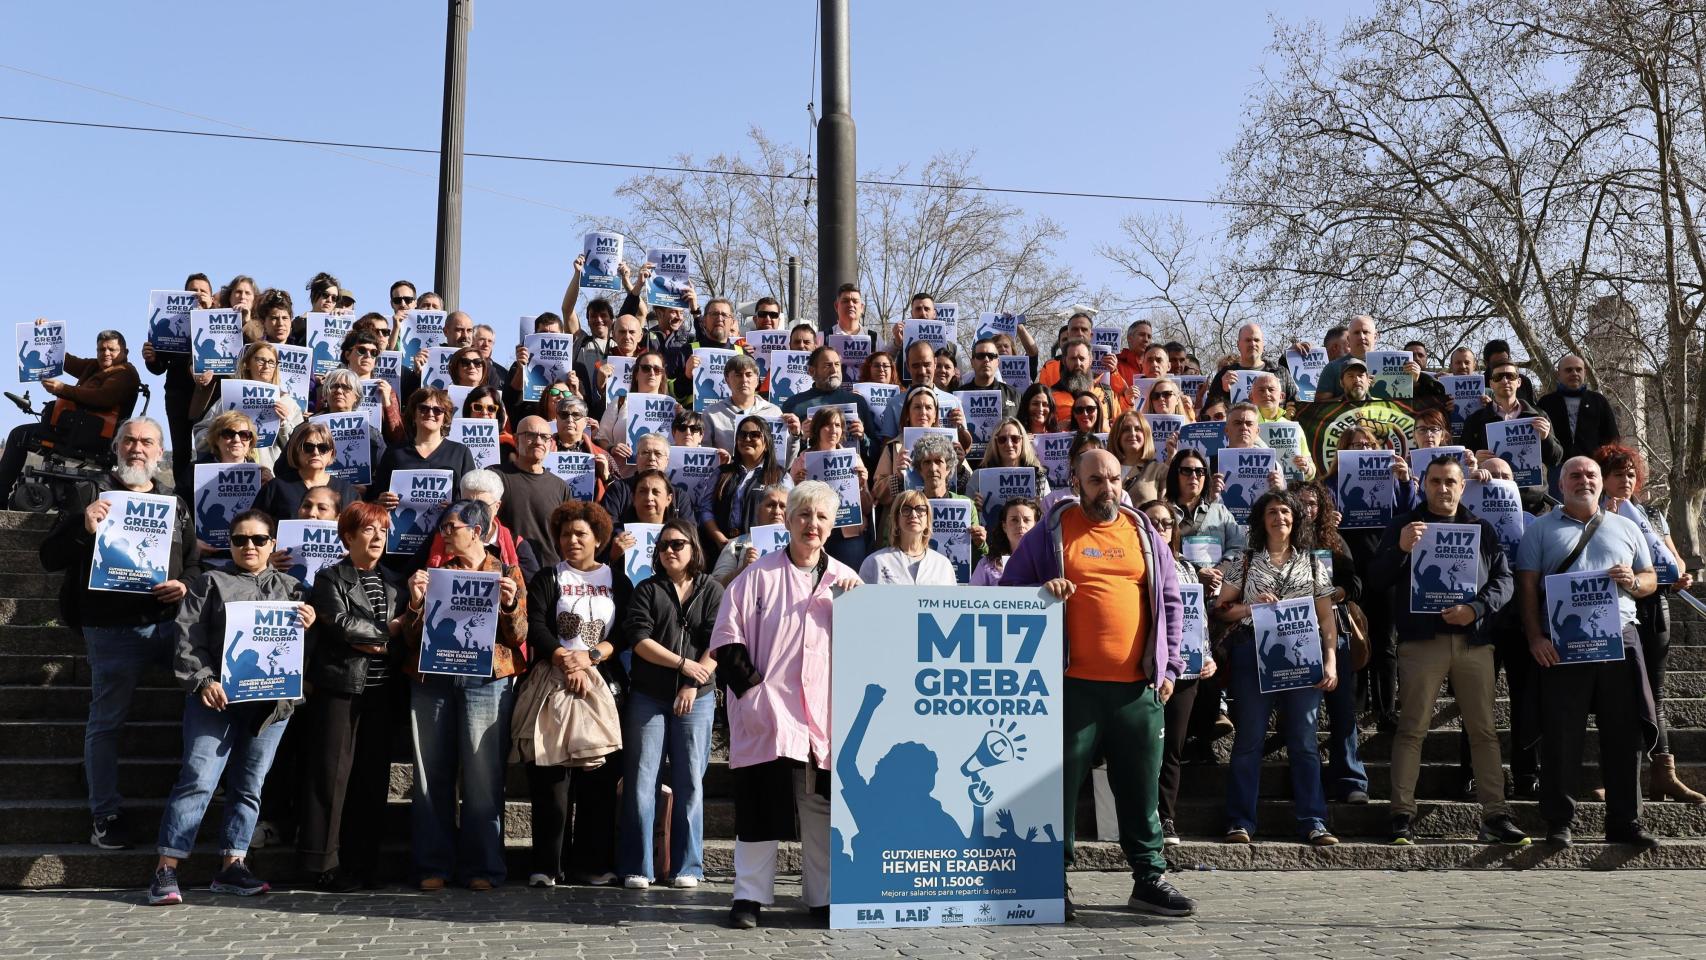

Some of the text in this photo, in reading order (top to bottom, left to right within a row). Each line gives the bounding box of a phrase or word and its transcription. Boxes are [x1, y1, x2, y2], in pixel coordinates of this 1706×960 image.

[596, 238, 618, 247] M17
[661, 254, 686, 263] M17
[167, 296, 194, 305] M17
[209, 314, 238, 324] M17
[324, 318, 352, 329] M17
[416, 315, 443, 324] M17
[34, 326, 62, 337] M17
[918, 325, 942, 334] M17
[541, 339, 568, 349] M17
[762, 335, 786, 344] M17
[844, 341, 867, 350] M17
[278, 350, 308, 363] M17
[1302, 353, 1324, 361] M17
[1383, 356, 1409, 365] M17
[1002, 361, 1026, 369] M17
[363, 386, 378, 395] 17
[1455, 381, 1481, 390] M17
[242, 386, 275, 397] M17
[870, 388, 896, 397] M17
[646, 400, 674, 411] M17
[970, 397, 997, 407] M17
[329, 417, 364, 428] M17
[769, 422, 782, 431] 17
[1152, 420, 1181, 431] M17
[462, 425, 493, 436] M17
[1269, 428, 1295, 438] M17
[1506, 424, 1534, 436] M17
[1045, 440, 1072, 450] M17
[684, 454, 715, 465] M17
[824, 456, 852, 469] M17
[1238, 455, 1271, 467] M17
[1359, 457, 1392, 469] M17
[218, 471, 255, 484] M17
[1000, 475, 1030, 486] M17
[411, 477, 448, 490] M17
[411, 490, 447, 498] GREBA
[1482, 487, 1514, 499] M17
[126, 500, 170, 518] M17
[934, 508, 966, 520] M17
[124, 517, 167, 529] GREBA
[123, 526, 166, 535] OROKORRA
[1436, 532, 1474, 546] M17
[302, 544, 343, 553] GREBA
[1435, 546, 1474, 555] GREBA
[452, 580, 494, 597] M17
[1570, 578, 1611, 593] M17
[451, 597, 493, 607] GREBA
[1180, 591, 1198, 604] 17
[1572, 592, 1612, 602] GREBA
[918, 599, 1046, 610] 17M HUELGA GENERAL
[1572, 599, 1613, 608] OROKORRA
[255, 609, 297, 626] M17
[1275, 606, 1309, 623] M17
[253, 627, 298, 636] GREBA
[1277, 621, 1313, 632] GREBA
[1278, 628, 1314, 636] OROKORRA
[918, 612, 1047, 663] M17
[915, 668, 1049, 696] GREBA
[914, 699, 1048, 715] OROKORRA
[882, 849, 1016, 859] GUTXIENEKO SOLDATA
[882, 859, 1015, 874] HEMEN ERABAKI
[914, 876, 984, 887] SMI 1.500€
[858, 909, 884, 920] ELA
[896, 908, 928, 922] LAB
[1006, 908, 1036, 920] HIRU
